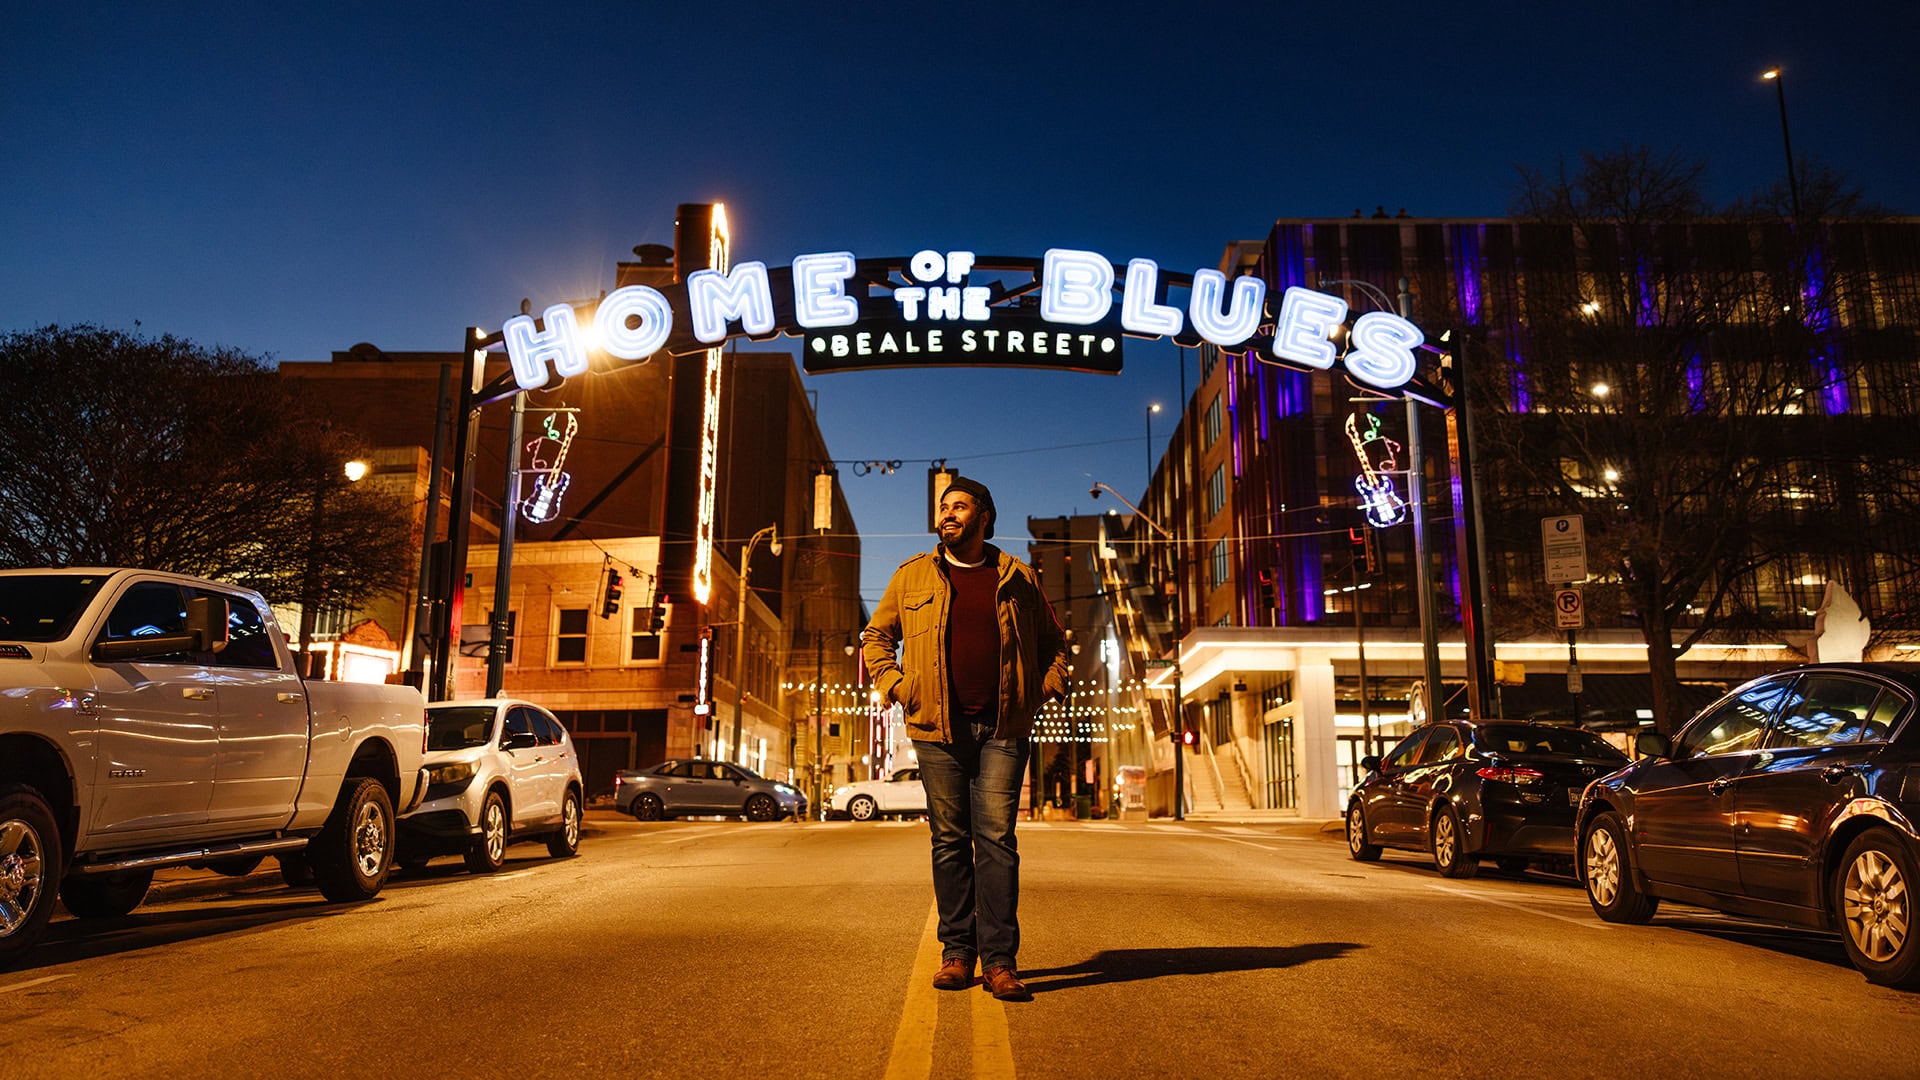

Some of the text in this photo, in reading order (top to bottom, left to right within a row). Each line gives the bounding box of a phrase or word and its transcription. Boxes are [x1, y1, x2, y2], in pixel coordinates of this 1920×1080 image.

[502, 248, 1425, 390] HOME OF THE BLUES
[831, 329, 1096, 357] BEALE STREET
[109, 769, 147, 778] RAM
